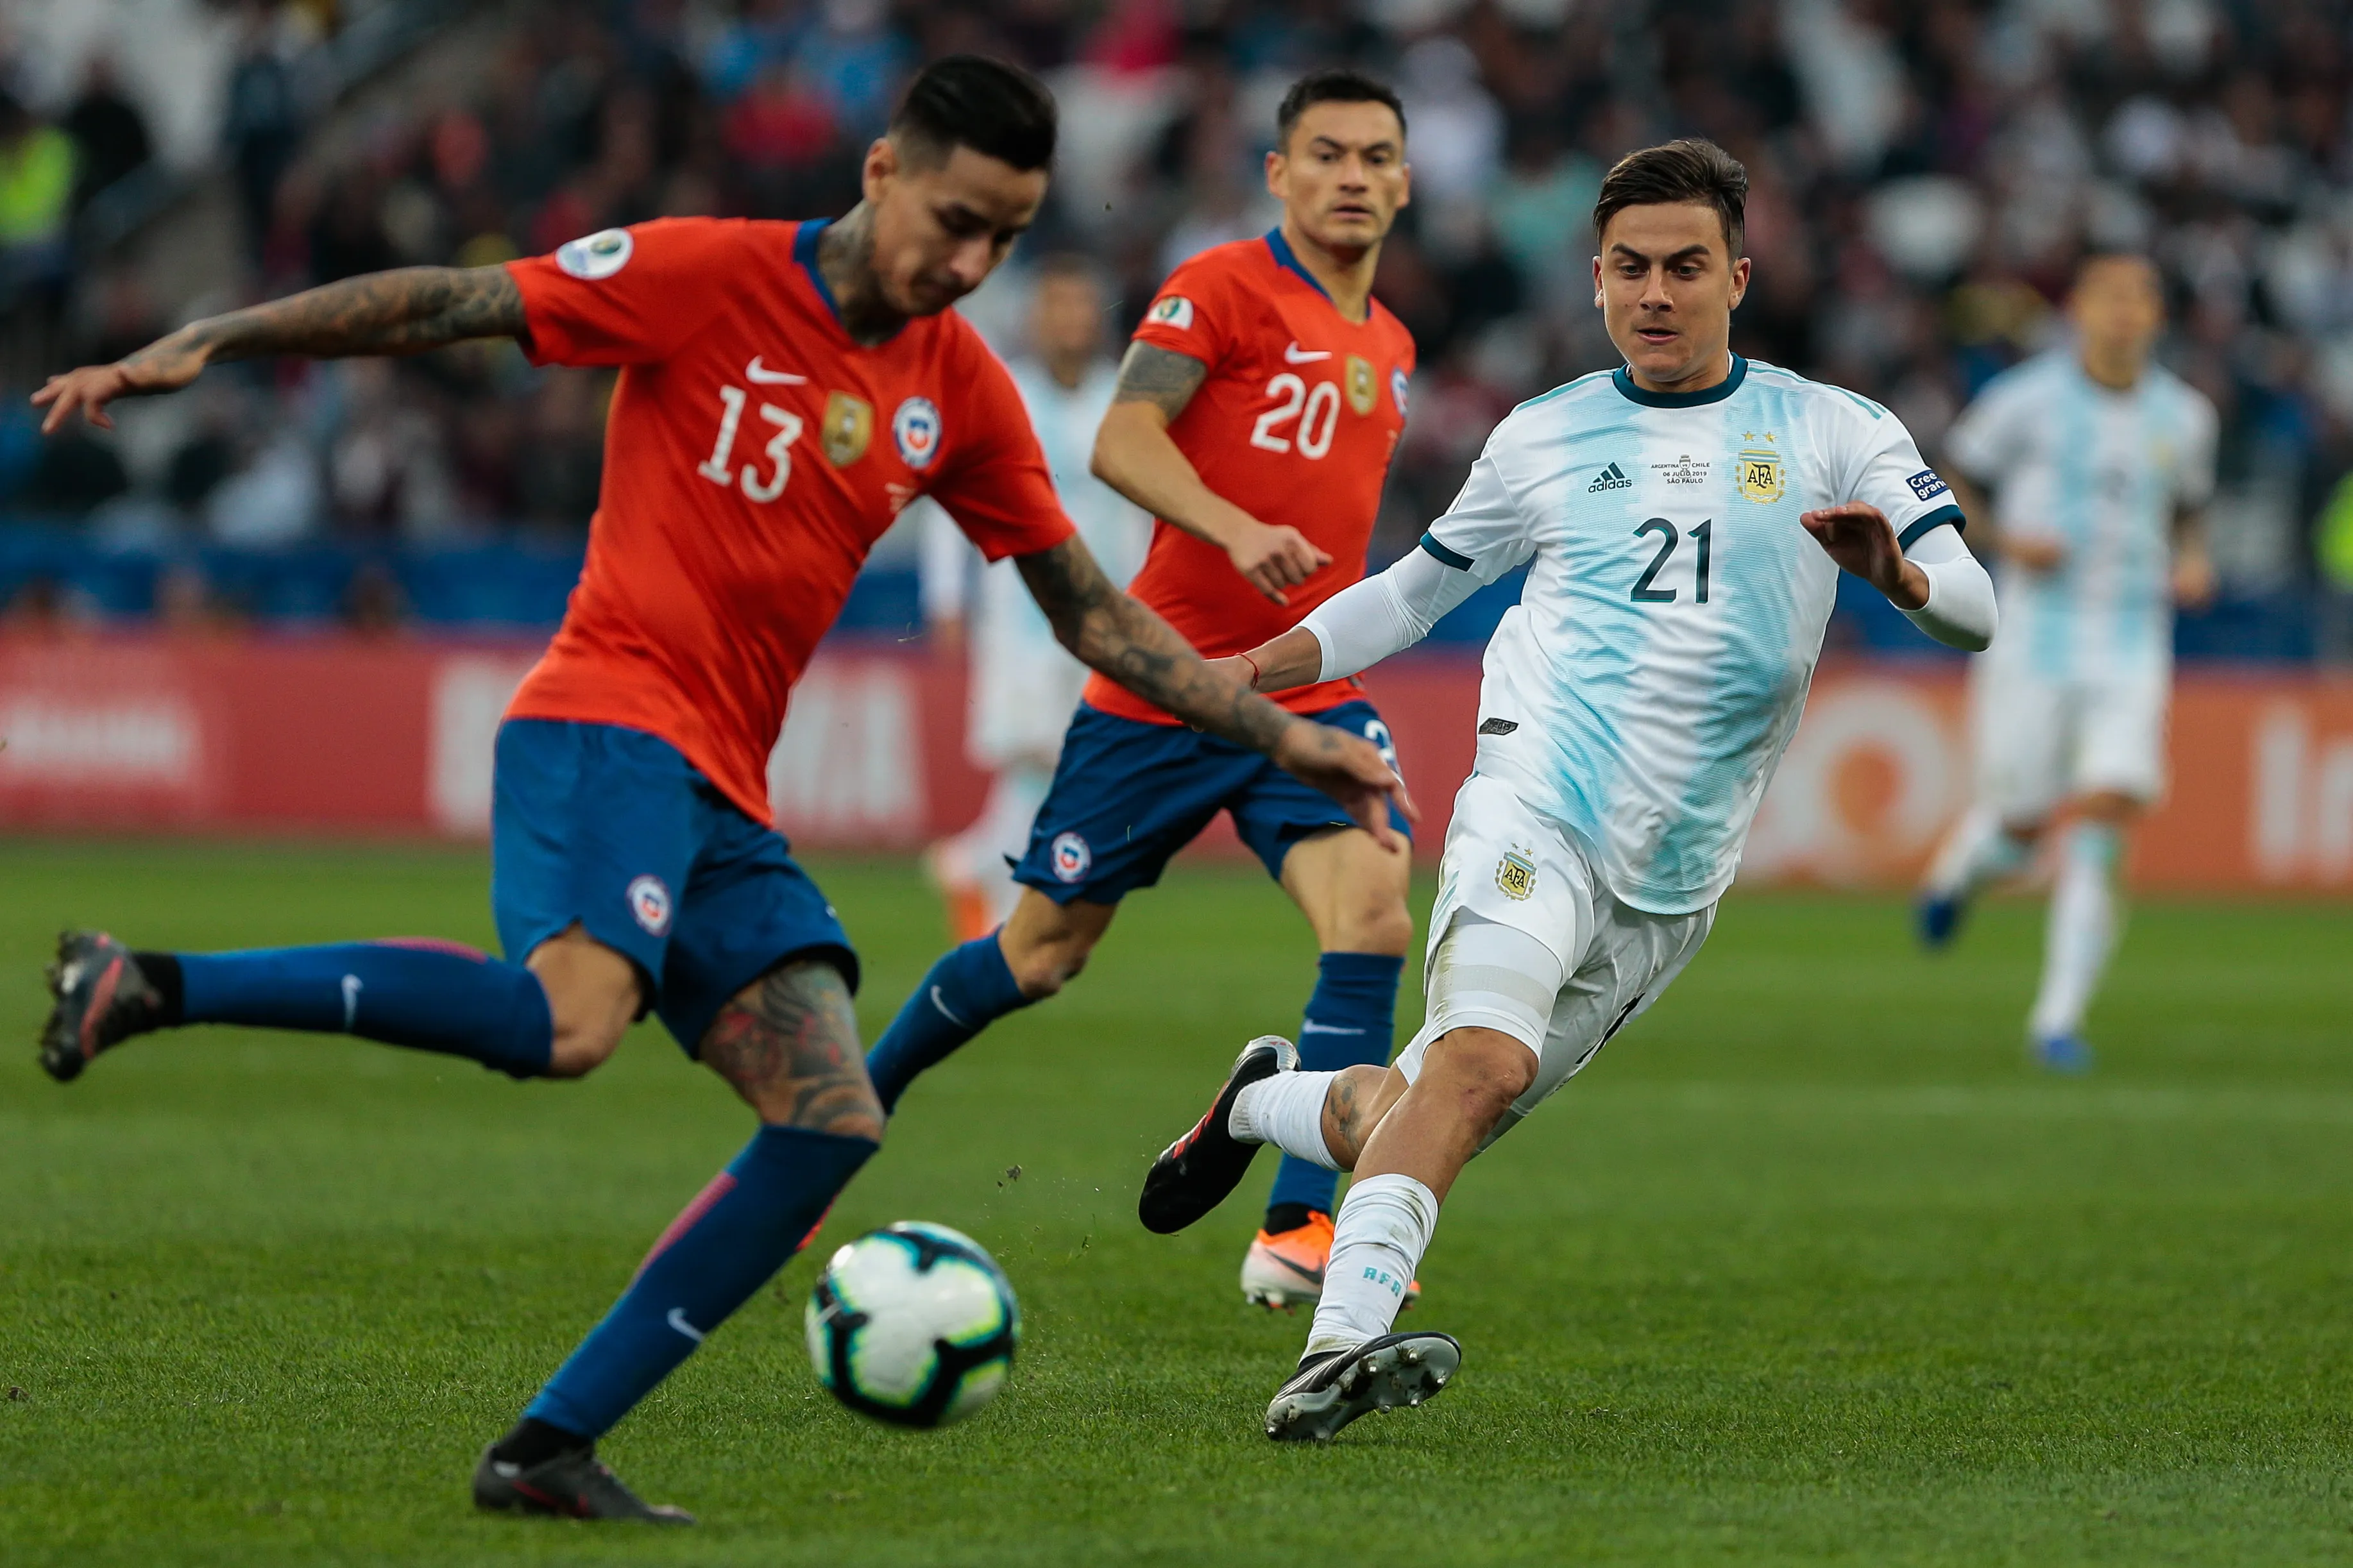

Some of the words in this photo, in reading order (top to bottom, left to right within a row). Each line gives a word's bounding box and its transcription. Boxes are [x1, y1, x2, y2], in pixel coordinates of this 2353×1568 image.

[1250, 373, 1341, 460] 20
[697, 384, 804, 503] 13
[1588, 479, 1633, 493] adidas
[1747, 462, 1774, 489] AFA
[1910, 473, 1937, 488] Cree
[1630, 517, 1712, 604] 21
[1504, 863, 1525, 889] AFA
[1363, 1267, 1402, 1297] AFA
